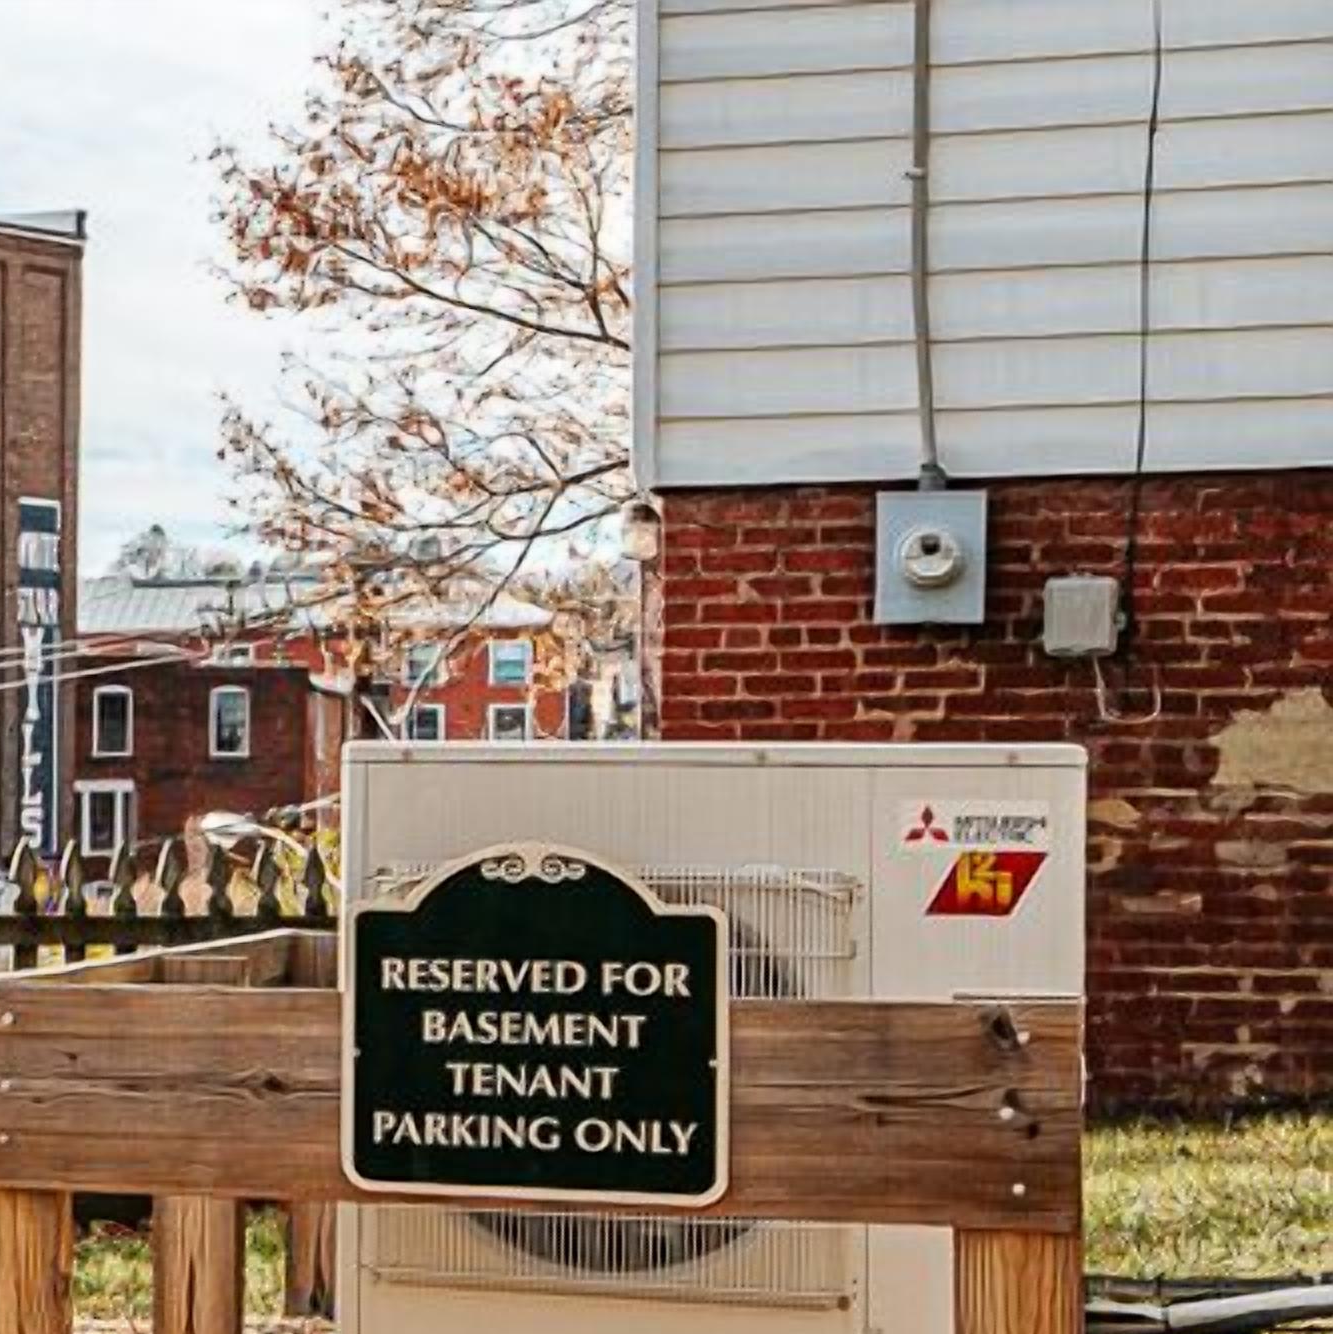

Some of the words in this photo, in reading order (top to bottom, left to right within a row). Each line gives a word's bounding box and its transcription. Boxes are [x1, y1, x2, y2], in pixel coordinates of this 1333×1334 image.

[381, 958, 587, 994] RESERVED
[601, 961, 691, 997] FOR
[422, 1010, 647, 1049] BASEMENT
[446, 1062, 619, 1100] TENANT
[372, 1111, 561, 1151] PARKING
[573, 1118, 698, 1156] ONLY
